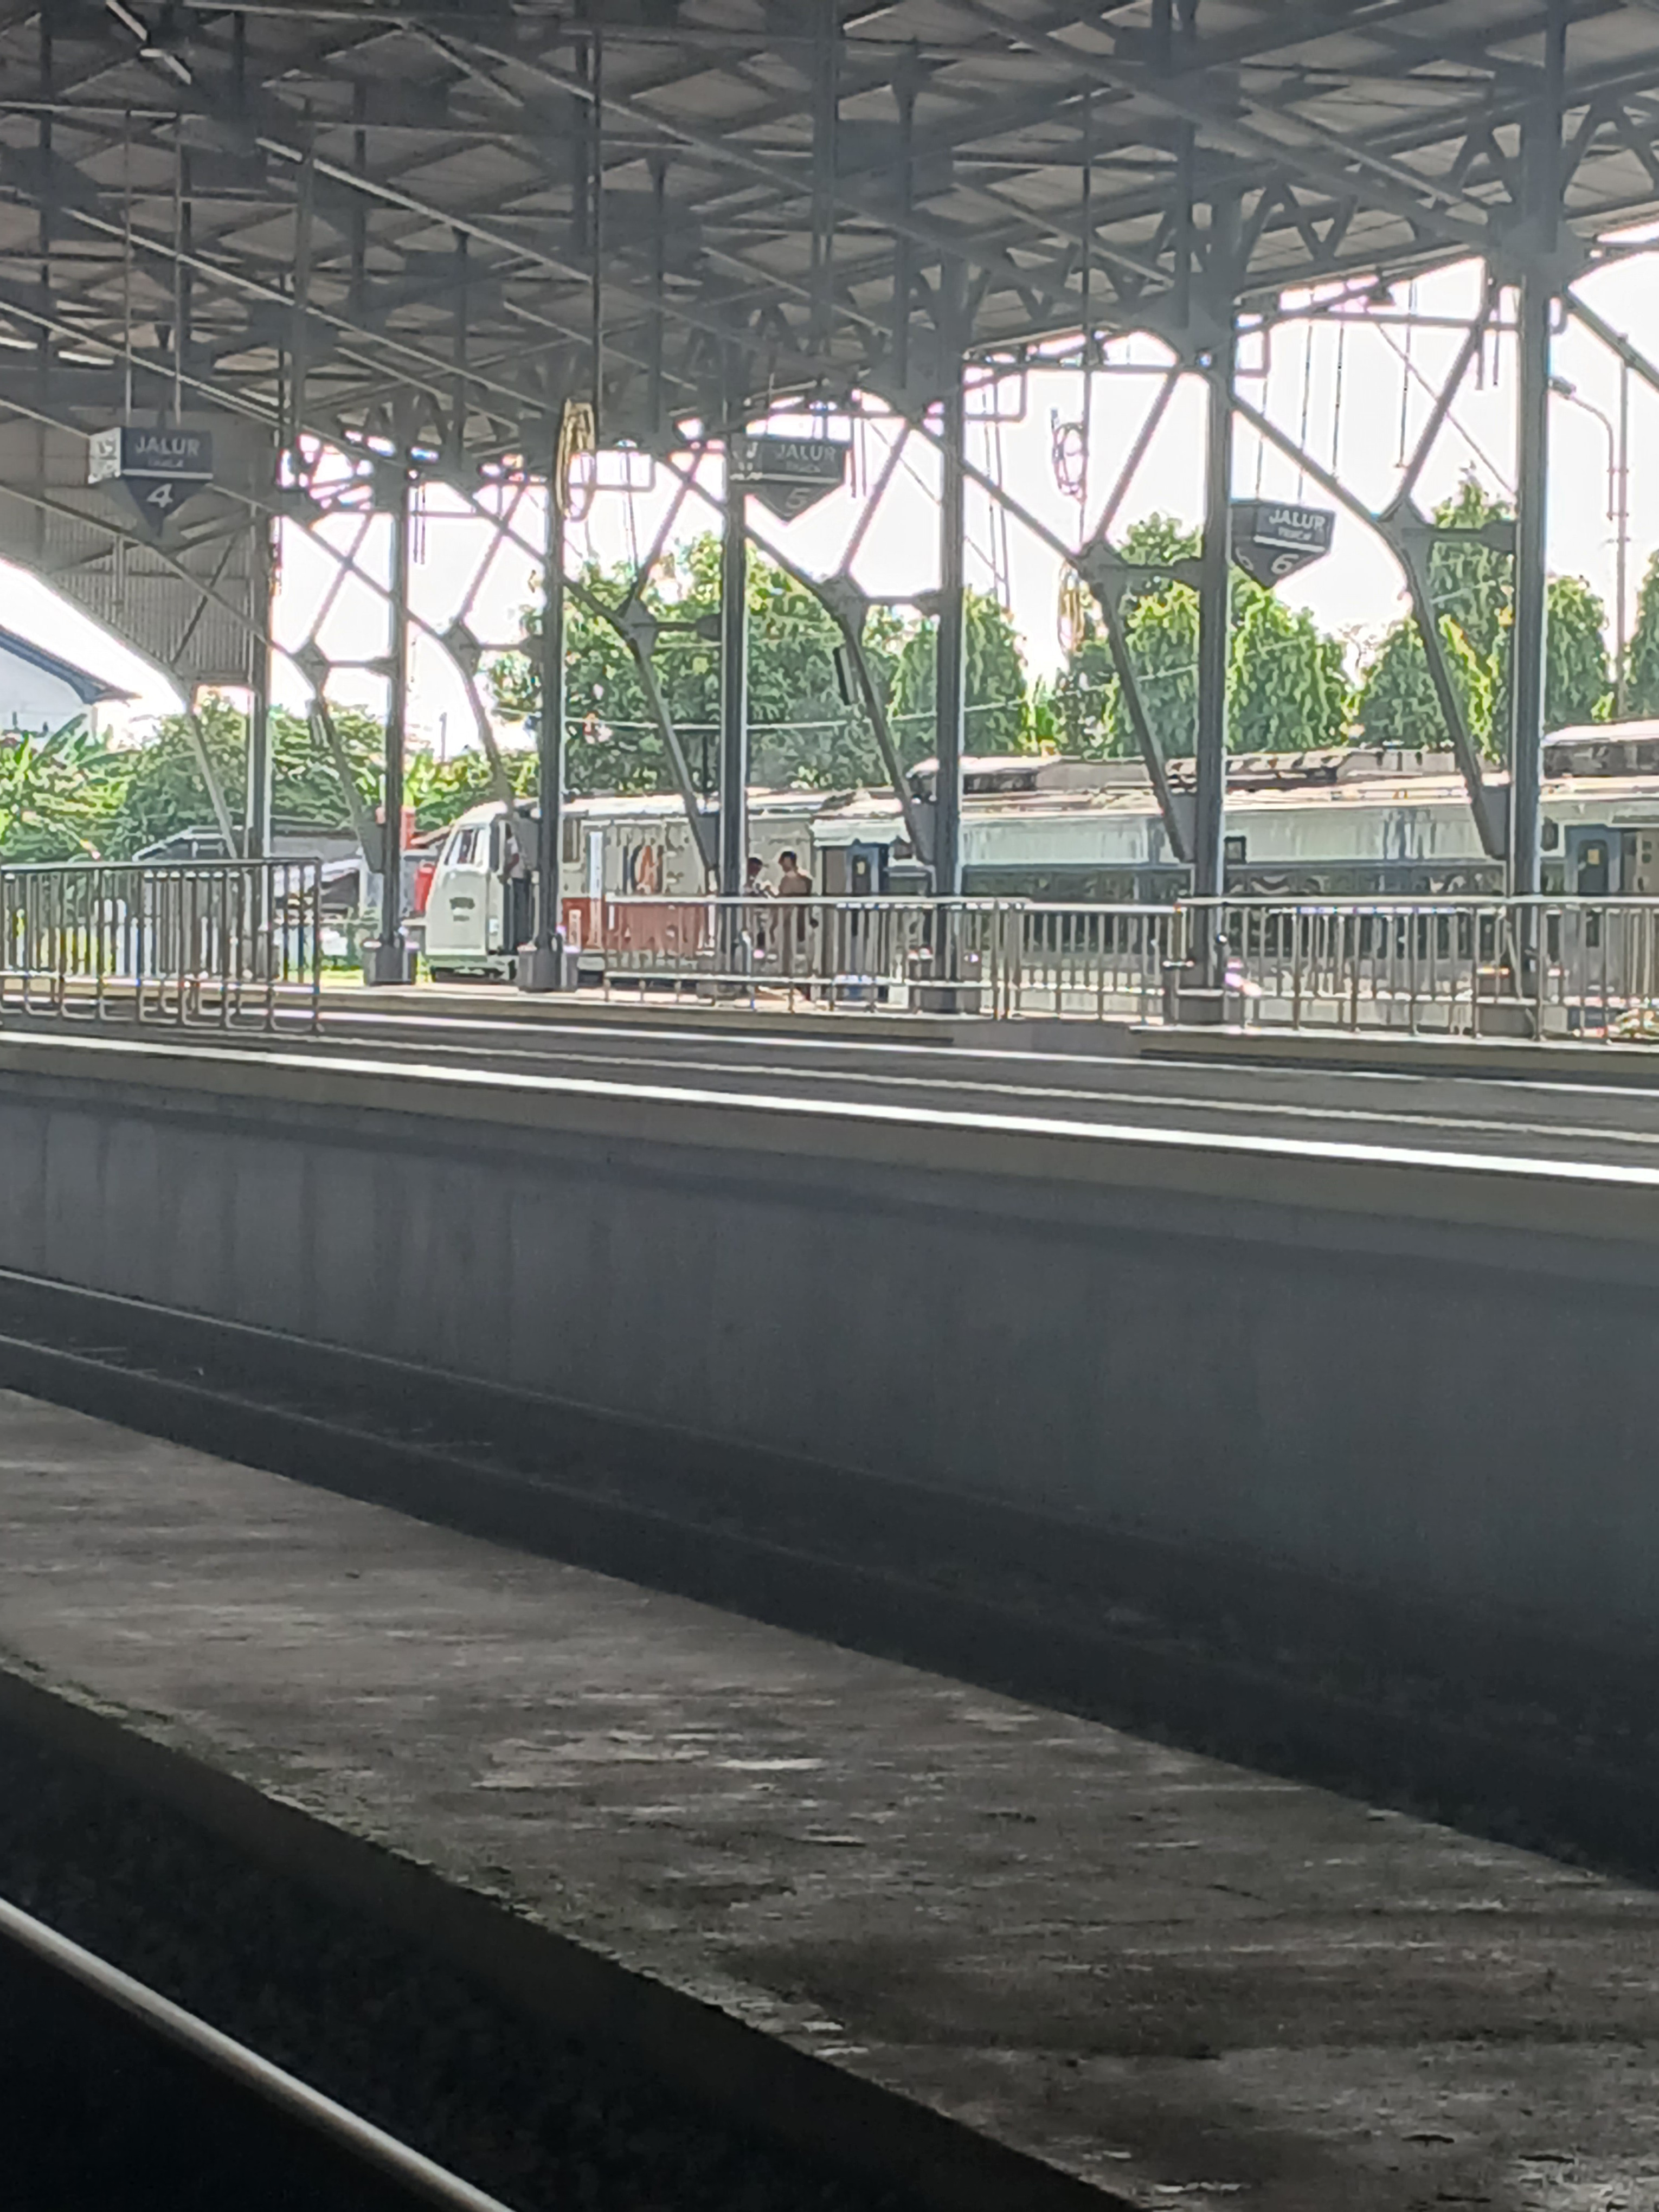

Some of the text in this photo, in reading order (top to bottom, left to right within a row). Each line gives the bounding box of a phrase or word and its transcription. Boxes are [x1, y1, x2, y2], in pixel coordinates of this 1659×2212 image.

[136, 436, 200, 456] JALUR
[774, 443, 837, 461] JALUR
[146, 483, 173, 508] 4
[786, 487, 811, 509] 5
[1269, 509, 1326, 531] JALUR
[1271, 553, 1300, 575] 6
